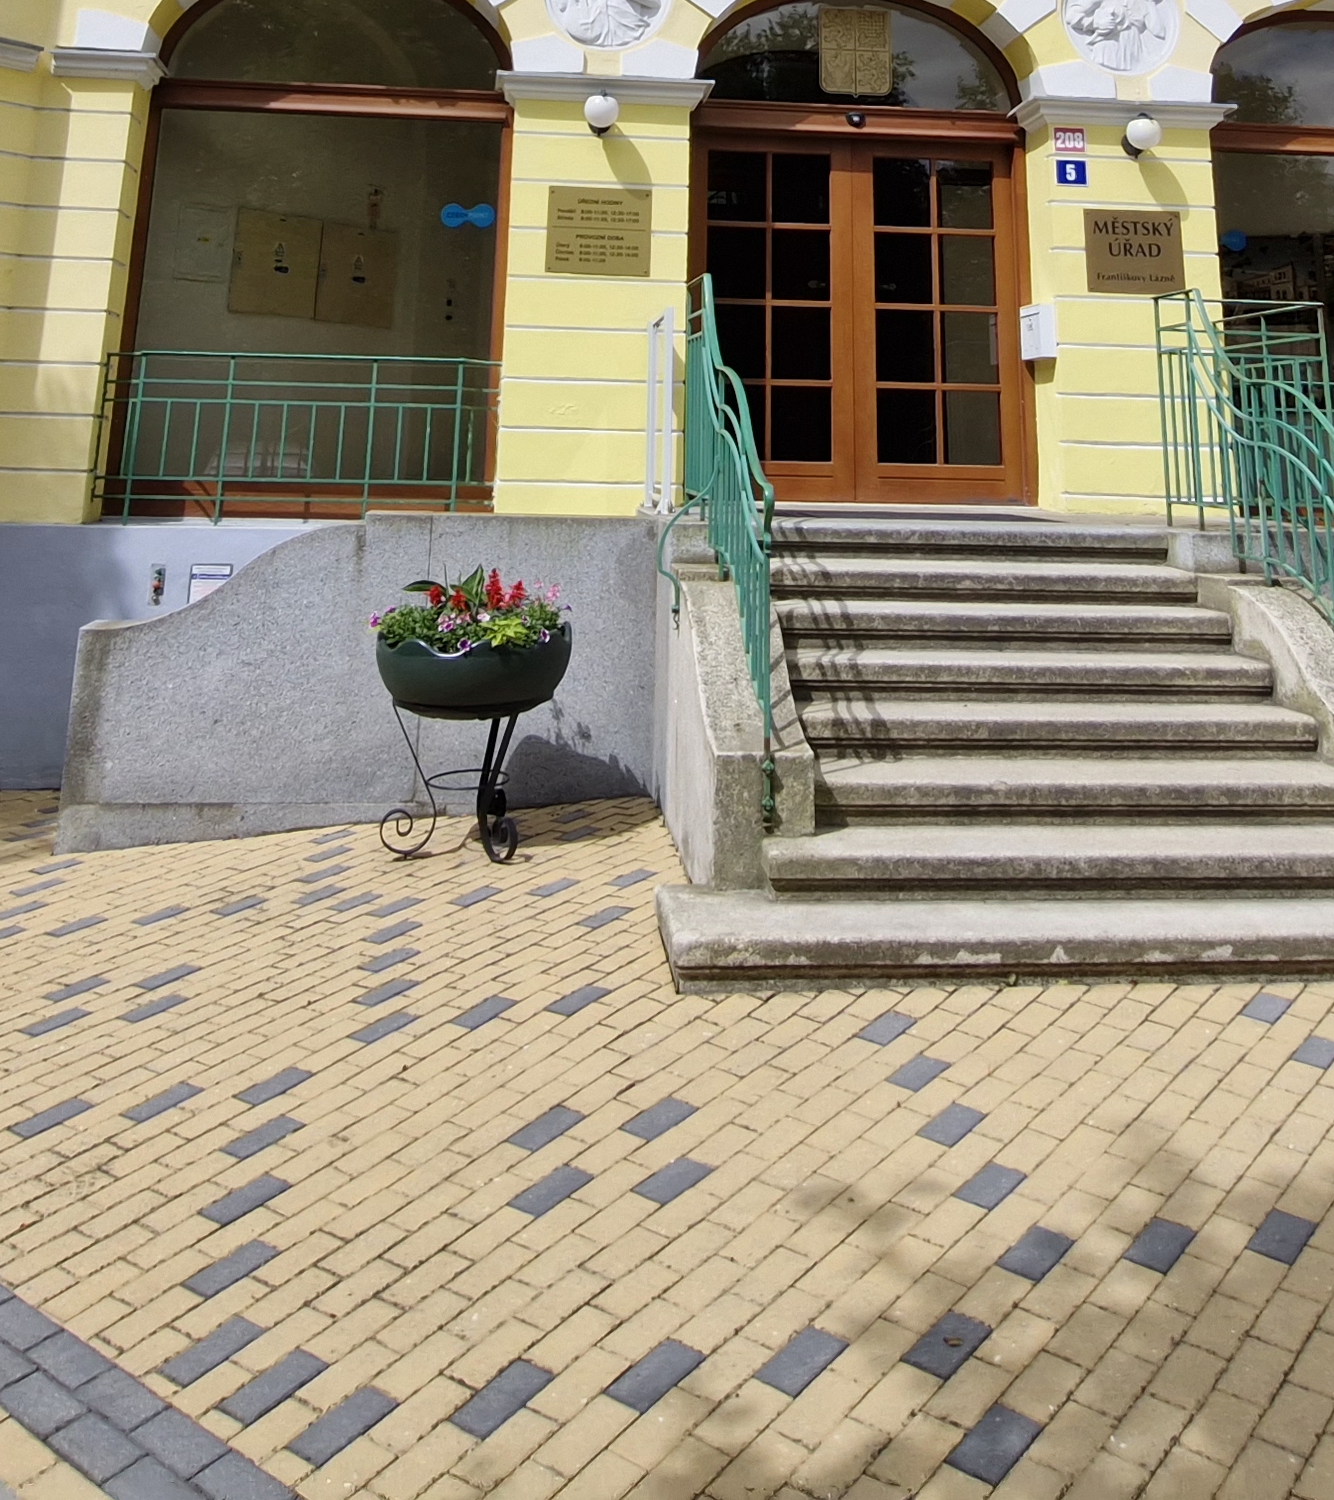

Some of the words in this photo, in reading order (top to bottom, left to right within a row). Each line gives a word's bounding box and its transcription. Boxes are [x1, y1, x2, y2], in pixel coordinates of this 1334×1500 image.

[1055, 131, 1084, 149] 208
[1065, 164, 1076, 181] 5
[1093, 217, 1174, 237] MĚSTSKÝ
[1108, 238, 1162, 258] ÚŘAD
